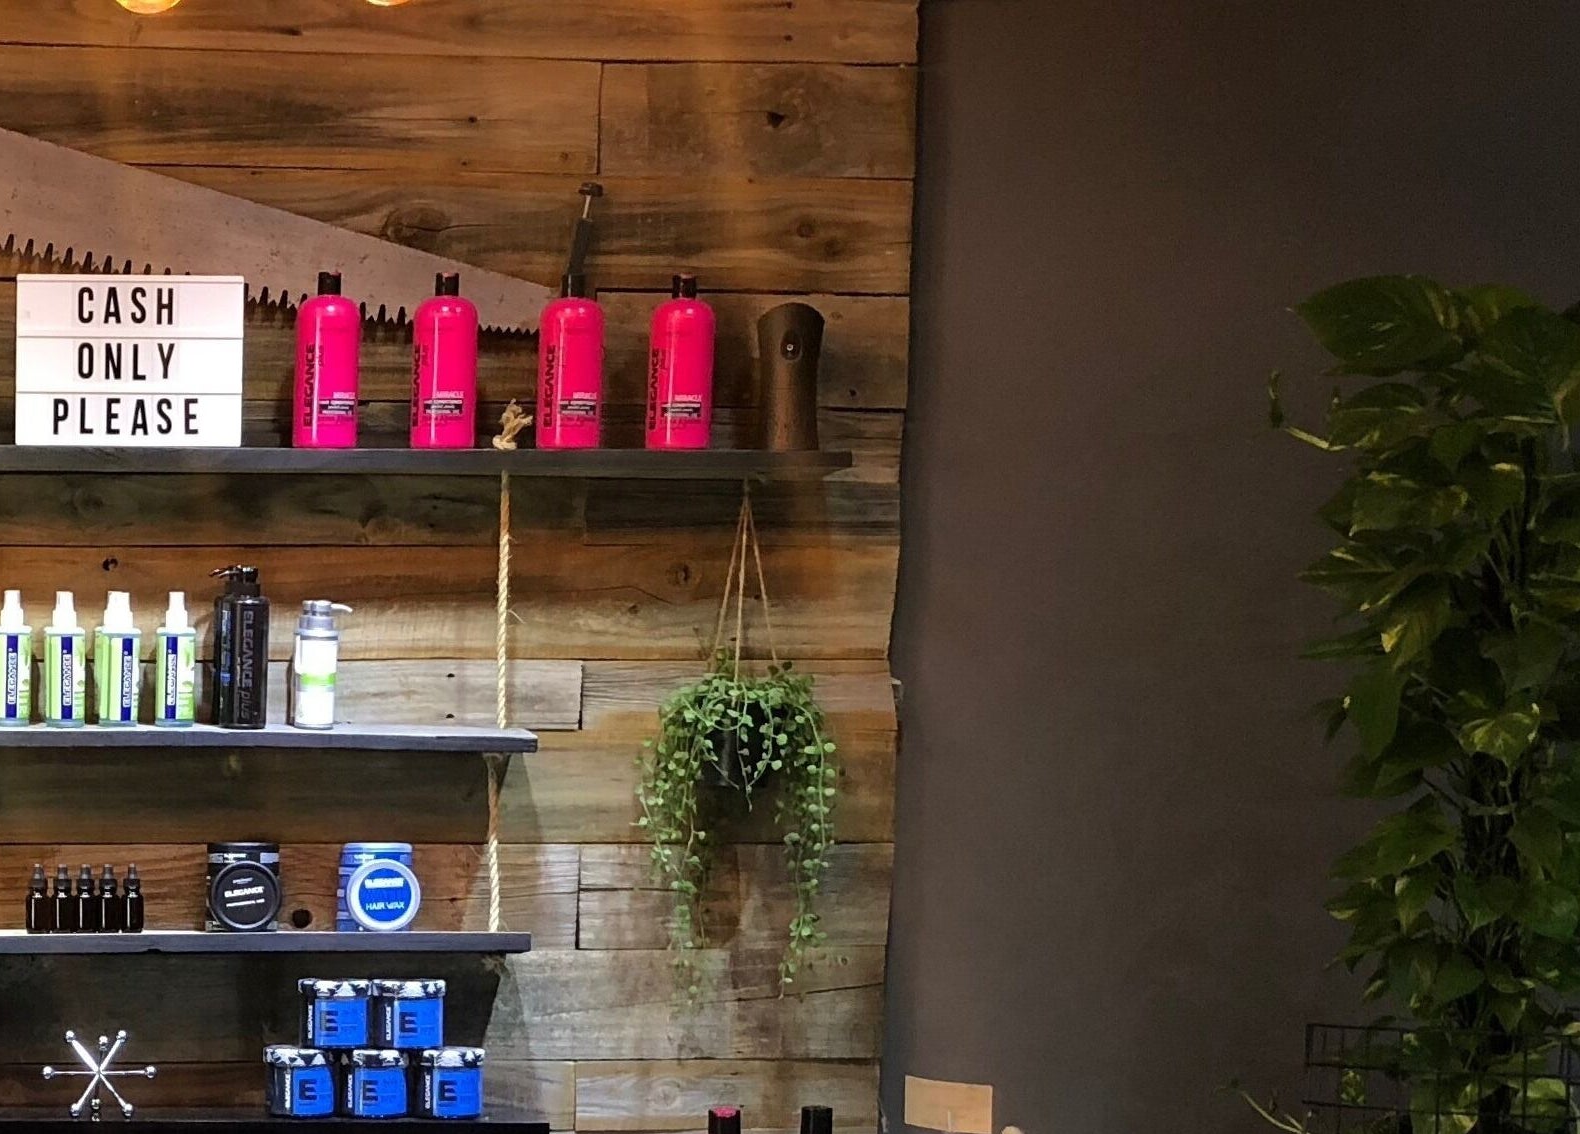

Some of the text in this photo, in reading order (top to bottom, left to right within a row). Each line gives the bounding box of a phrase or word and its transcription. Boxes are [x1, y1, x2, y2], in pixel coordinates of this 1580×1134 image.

[77, 286, 174, 325] CASH
[77, 342, 175, 381] ONLY
[303, 344, 316, 428] ELEGANCE
[412, 344, 421, 428] ELEGANCE
[543, 344, 556, 429] ELEGANCE
[648, 347, 660, 431] ELEGANCE
[53, 397, 199, 436] PLEASE
[240, 610, 254, 719] ELEGANCE plus
[365, 901, 405, 911] HAIR WAX
[399, 1011, 418, 1033] E
[299, 1078, 317, 1100] E
[362, 1079, 379, 1101] E
[438, 1079, 457, 1101] E
